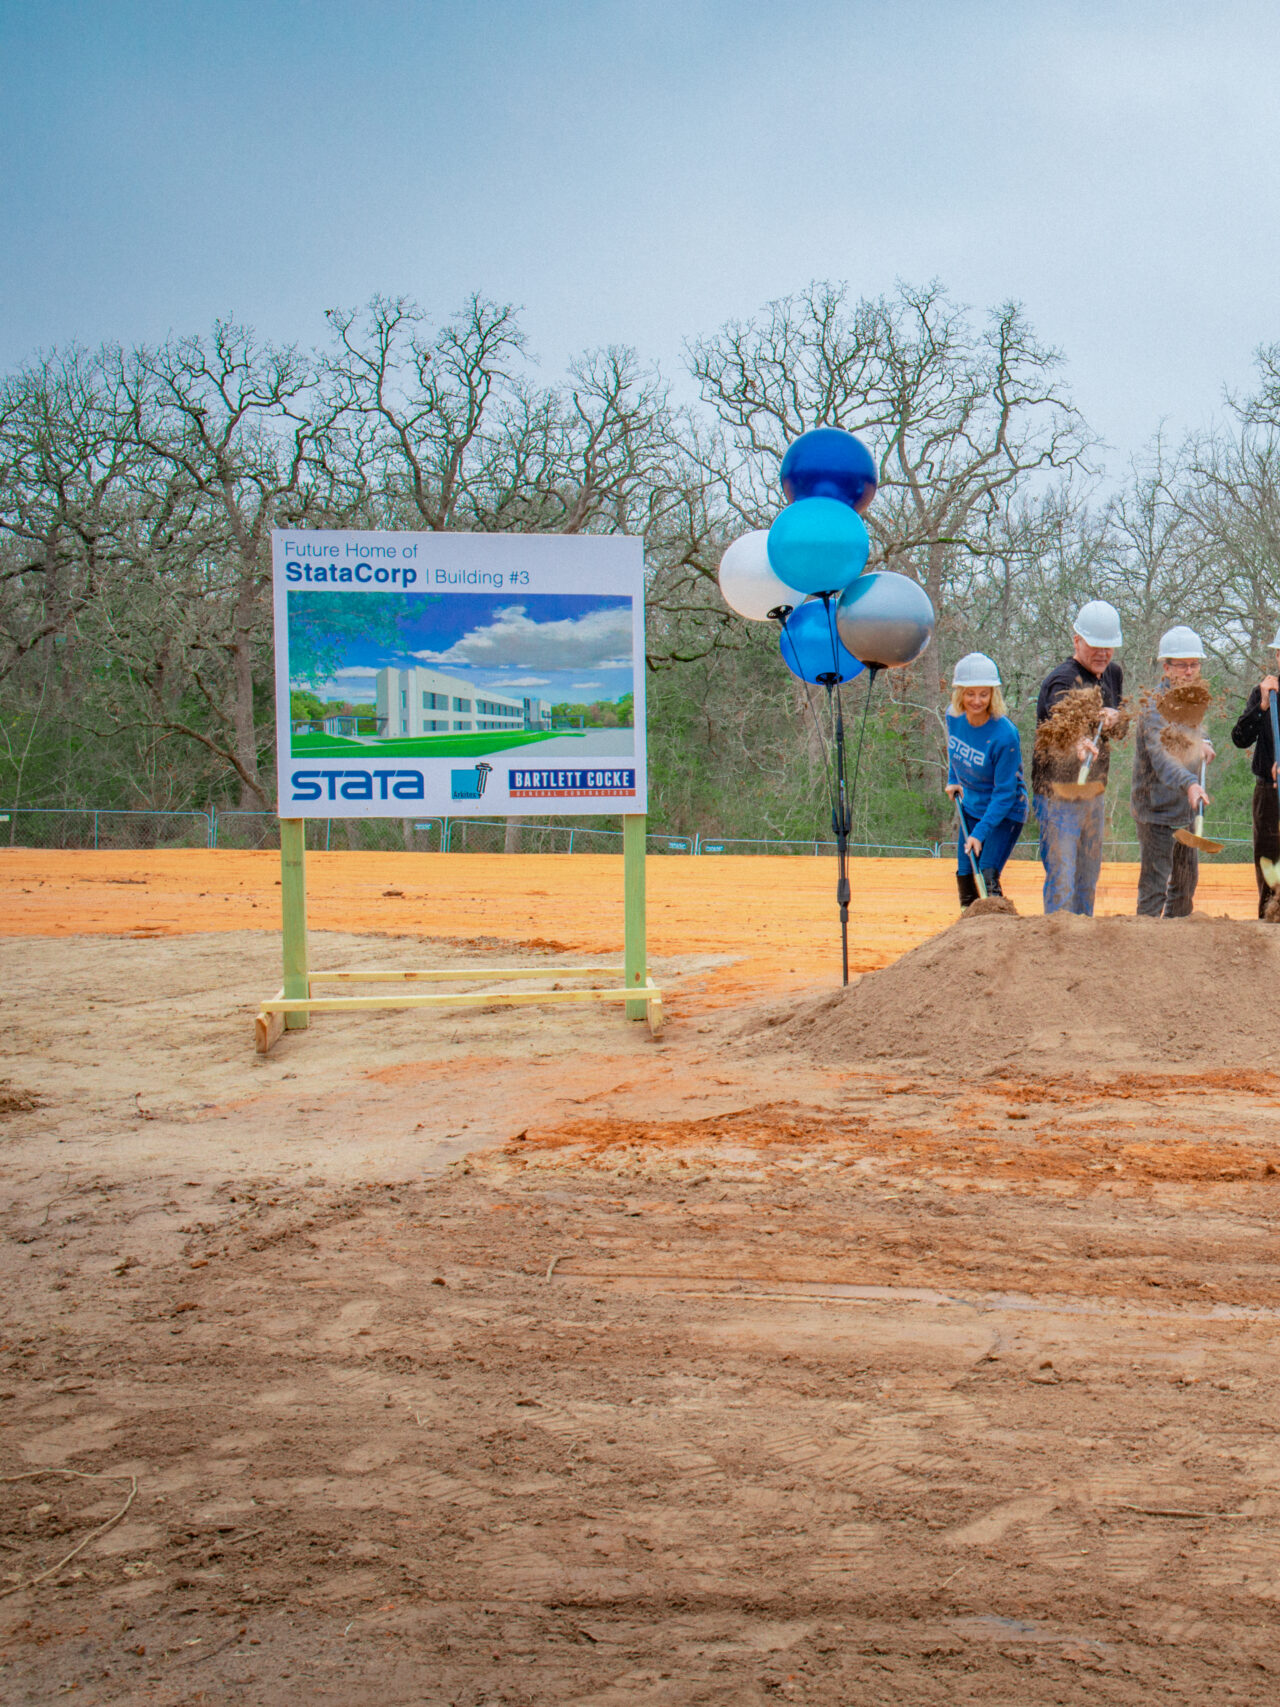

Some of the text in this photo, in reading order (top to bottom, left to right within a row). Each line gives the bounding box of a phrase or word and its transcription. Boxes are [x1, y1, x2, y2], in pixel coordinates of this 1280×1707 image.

[285, 541, 419, 558] Future Home of
[285, 561, 530, 588] StataCorp Building #3
[514, 771, 630, 788] BARTLETT COCKE
